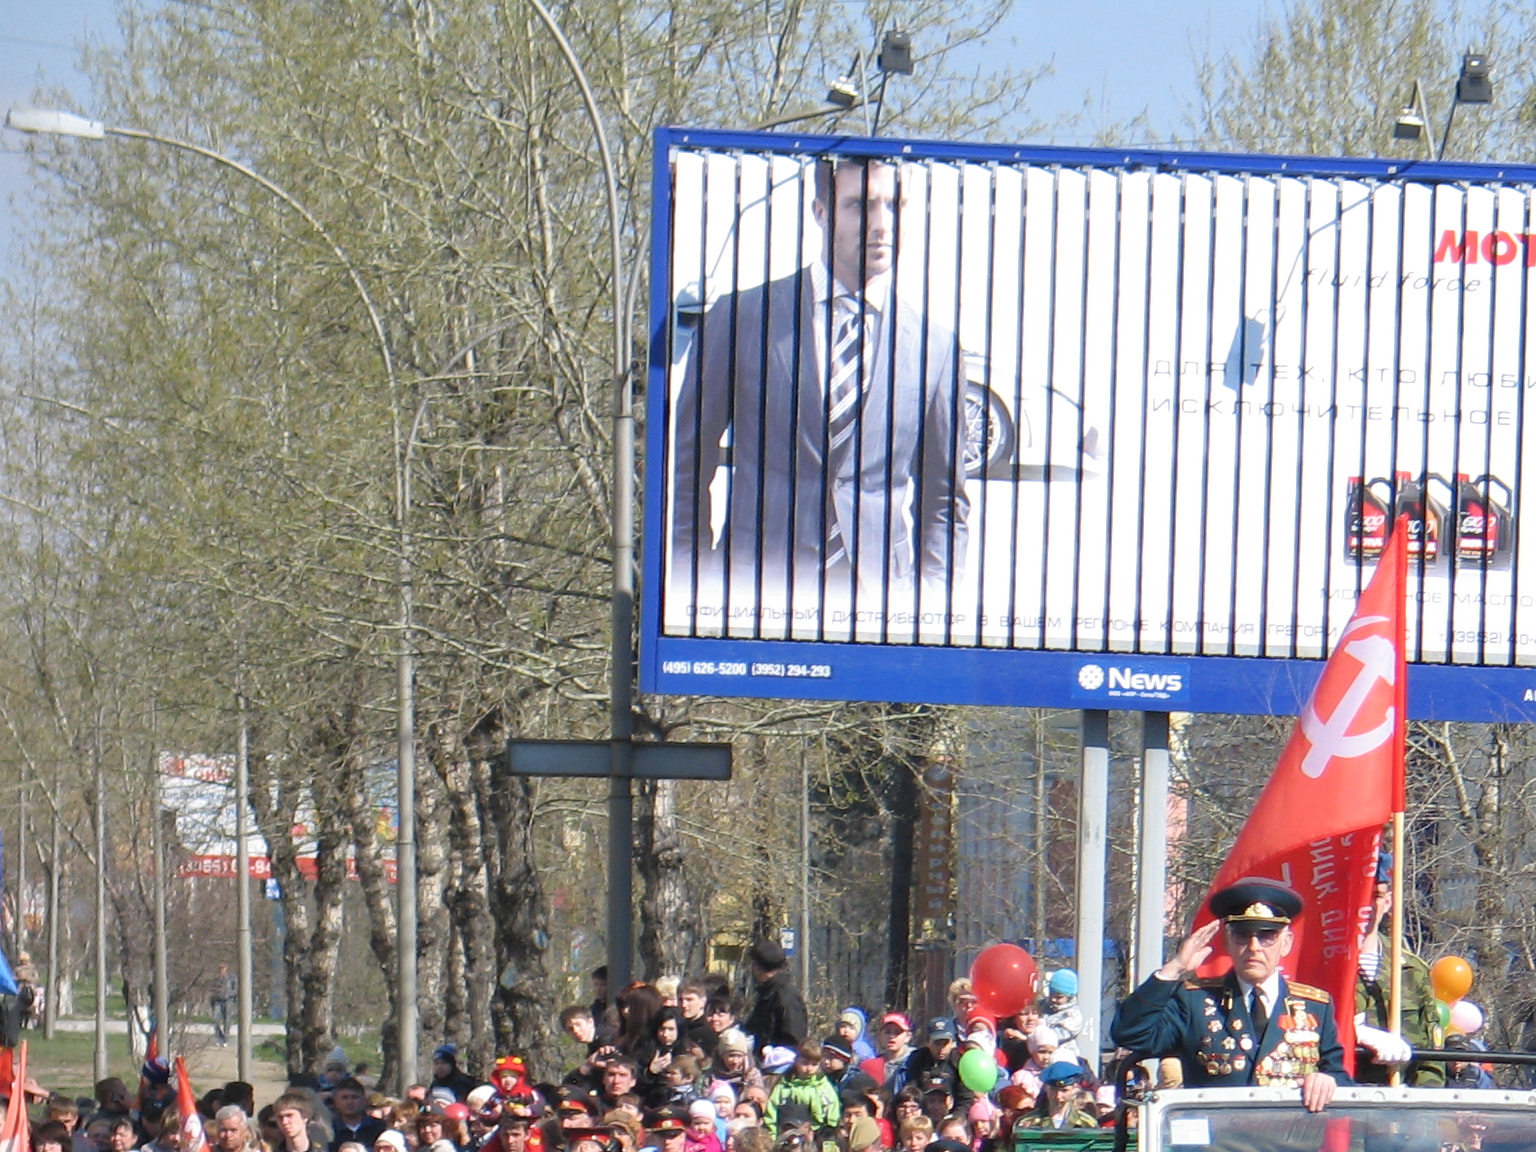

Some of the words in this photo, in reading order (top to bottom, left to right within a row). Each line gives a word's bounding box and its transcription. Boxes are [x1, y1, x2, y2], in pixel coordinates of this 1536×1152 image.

[1300, 268, 1388, 288] fluid
[1398, 271, 1481, 292] force
[1349, 366, 1417, 384] КТО
[1152, 398, 1511, 426] ИСКЛЮЧИТЕЛЬНОЕ
[662, 660, 691, 674] (495)
[693, 661, 747, 676] 626-5200
[751, 662, 785, 677] (3952)
[787, 664, 831, 678] 294-293
[1108, 667, 1182, 691] News
